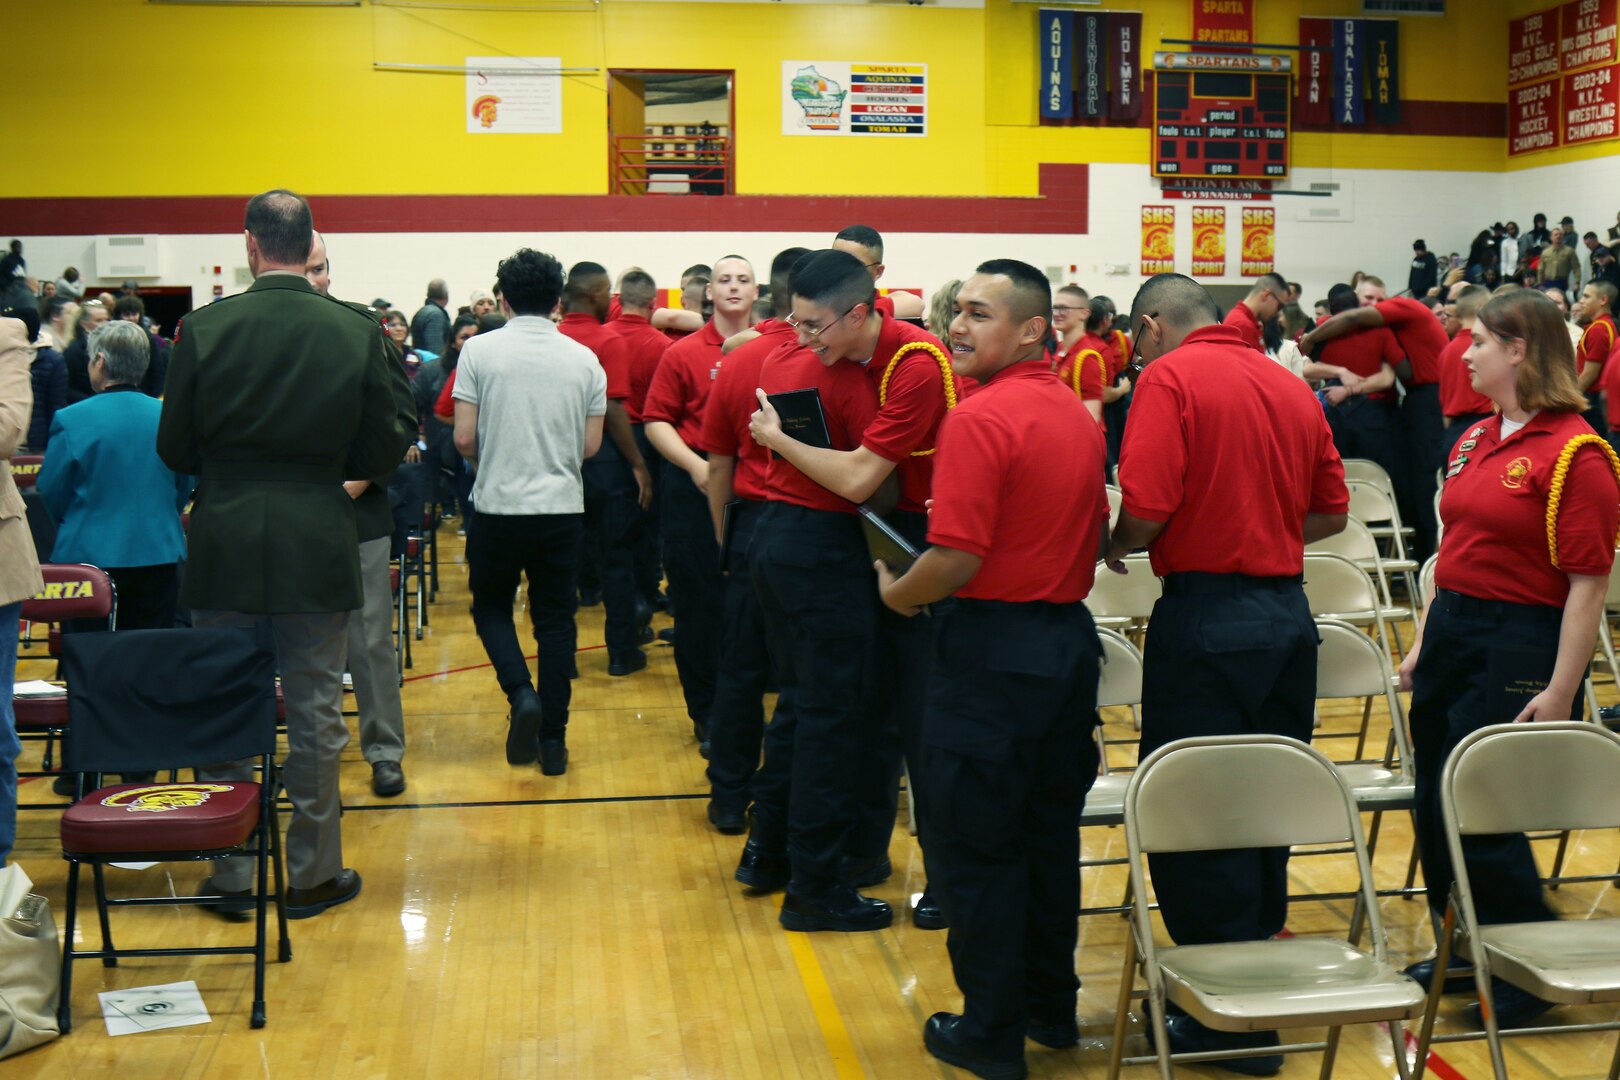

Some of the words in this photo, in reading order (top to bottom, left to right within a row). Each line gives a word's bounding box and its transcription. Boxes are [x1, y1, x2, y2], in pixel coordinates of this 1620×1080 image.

[1202, 0, 1244, 14] SPARTA
[1197, 28, 1249, 43] SPARTANS
[1535, 42, 1554, 59] GOLF
[1567, 43, 1611, 67] CHAMPIONS
[1050, 17, 1061, 111] AQUINAS
[1086, 16, 1098, 115] CENTRAL
[1120, 26, 1132, 105] HOLMEN
[1186, 55, 1260, 69] SPARTANS
[865, 75, 911, 84] AQUINAS
[1344, 20, 1354, 123] ONALASKA
[1377, 40, 1389, 103] TOMAH
[1574, 69, 1610, 90] 2003-04
[866, 104, 907, 113] LOGAN
[1210, 110, 1236, 122] period
[1568, 102, 1615, 124] WRESTLING
[859, 115, 914, 124] ONALASKA
[1520, 116, 1548, 134] HOCKEY
[1159, 126, 1179, 137] fouls
[1209, 125, 1236, 138] player
[1266, 128, 1285, 138] fouls
[1568, 119, 1614, 141] CHAMPIONS
[1514, 130, 1553, 151] CHAMPIONS
[1160, 163, 1178, 172] won
[1211, 164, 1233, 174] game
[1266, 165, 1284, 174] won
[1182, 190, 1252, 200] GYMNASIUM
[1142, 207, 1173, 224] SHS
[1193, 208, 1224, 225] SHS
[1243, 209, 1274, 226] SHS
[1142, 260, 1174, 273] TEAM
[1193, 262, 1224, 274] SPIRIT
[1242, 262, 1273, 274] PRIDE
